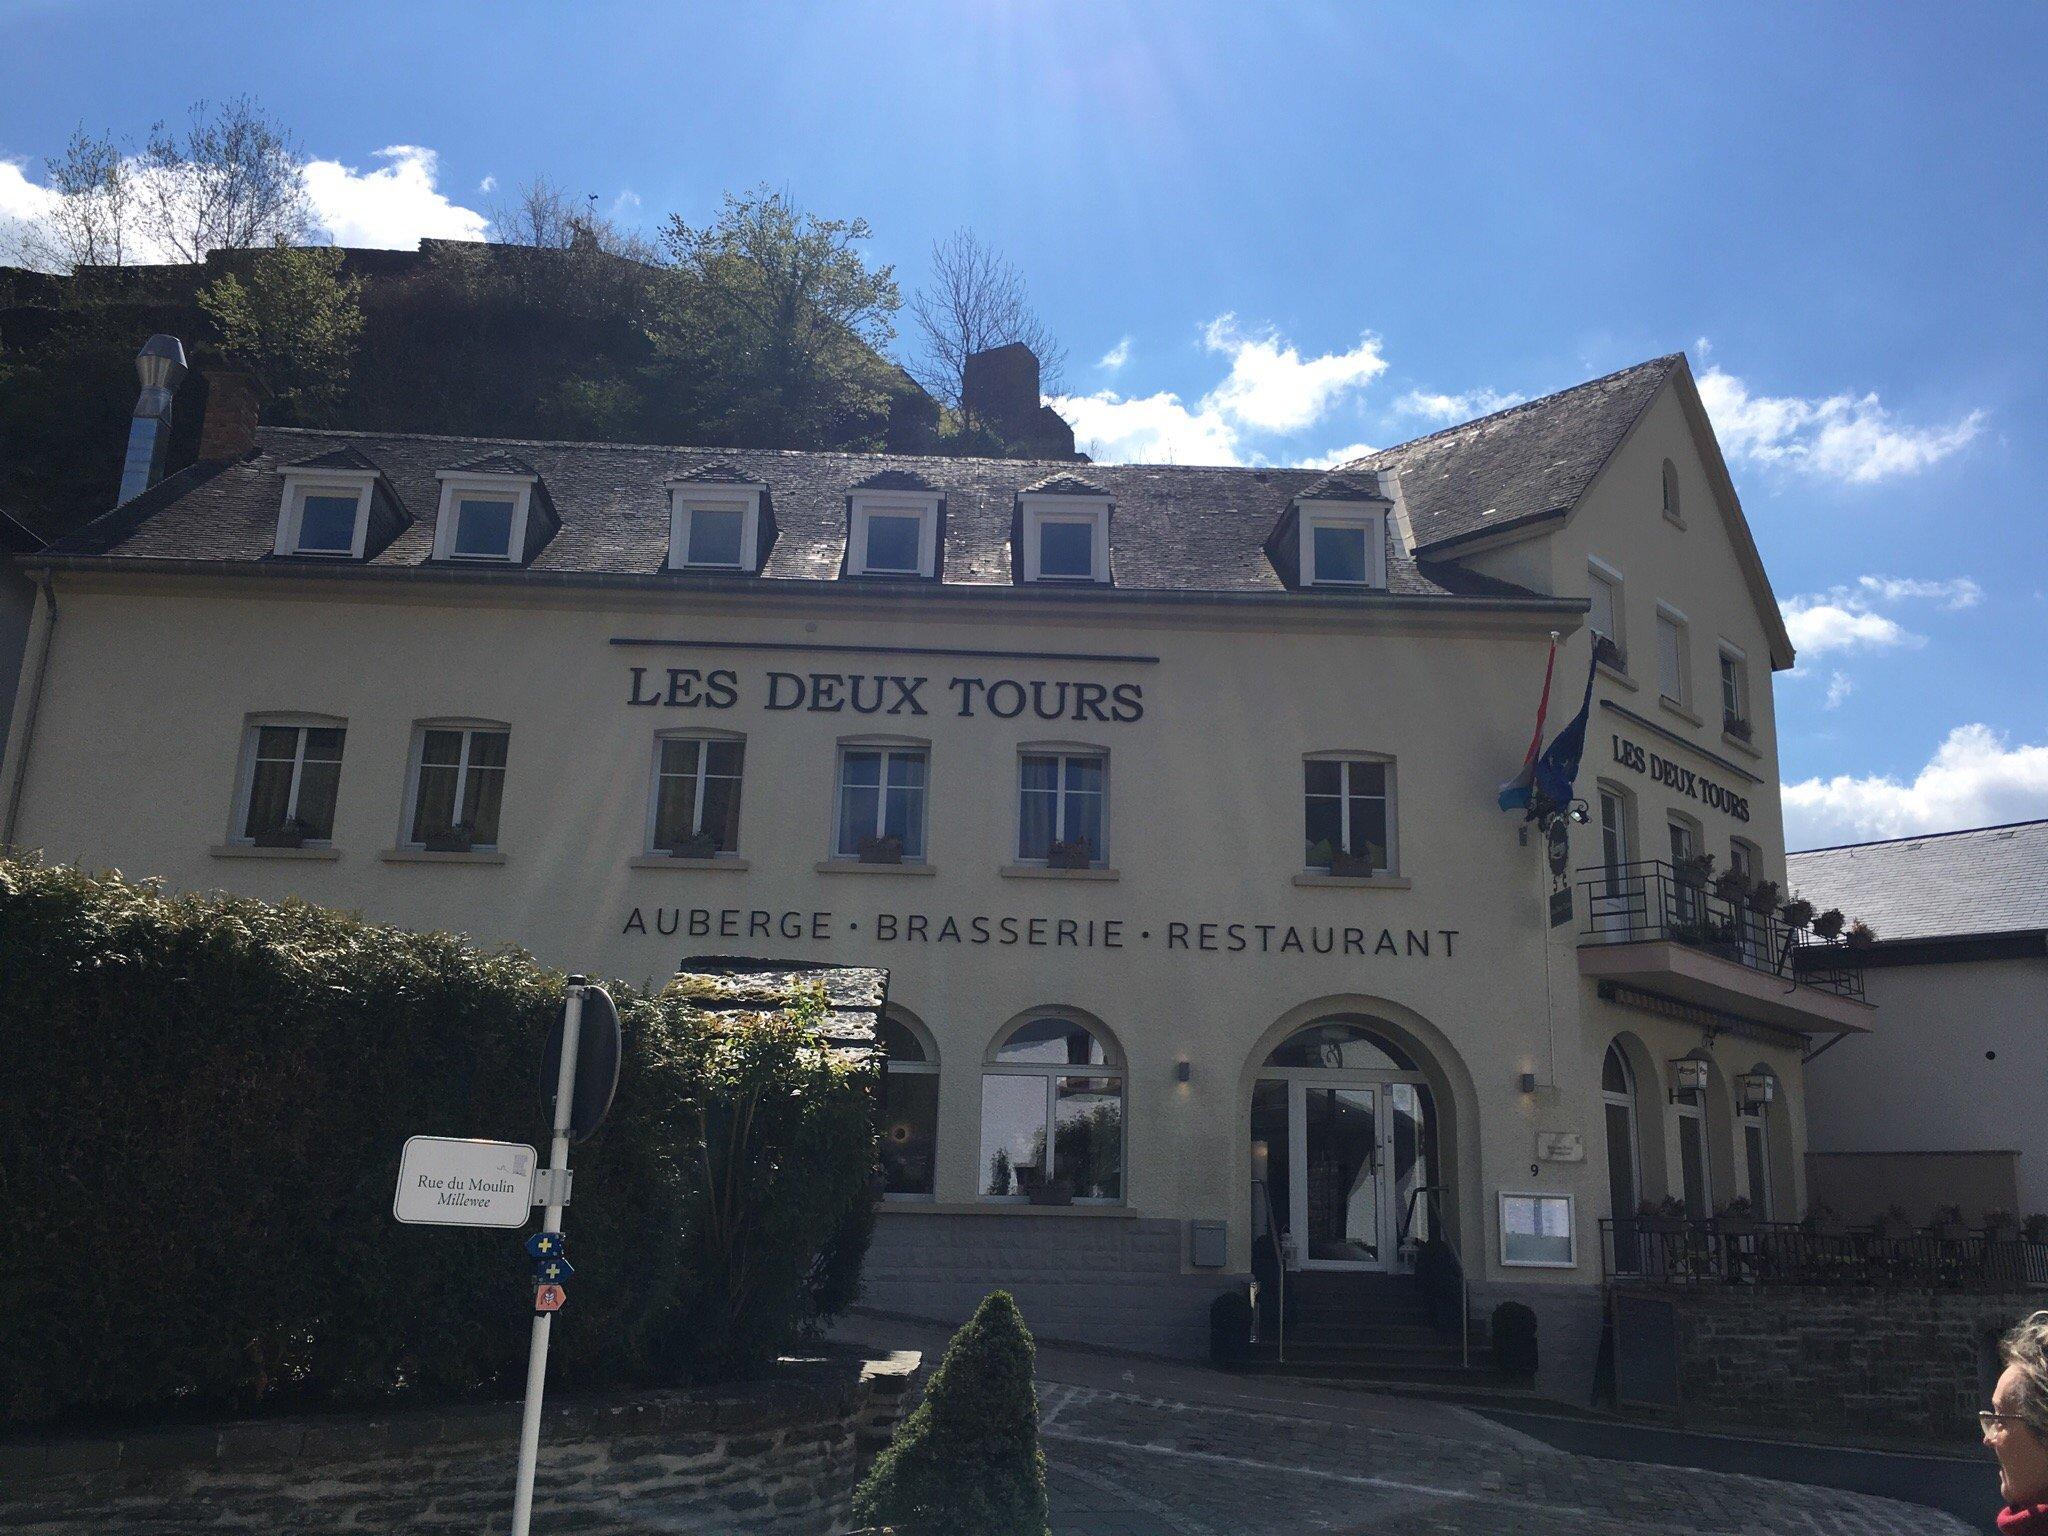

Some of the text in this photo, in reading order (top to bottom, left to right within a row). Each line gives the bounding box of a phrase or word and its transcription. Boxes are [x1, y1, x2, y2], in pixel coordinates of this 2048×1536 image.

[626, 667, 1145, 723] LES DEUX TOURS
[1612, 734, 1750, 822] LES DEUX TOURS
[622, 907, 1460, 957] AUBERGE BRASSERIE RESTAURANT
[417, 1174, 515, 1193] Rue du Moulin
[1530, 1163, 1539, 1177] 9
[437, 1192, 491, 1208] Millewee
